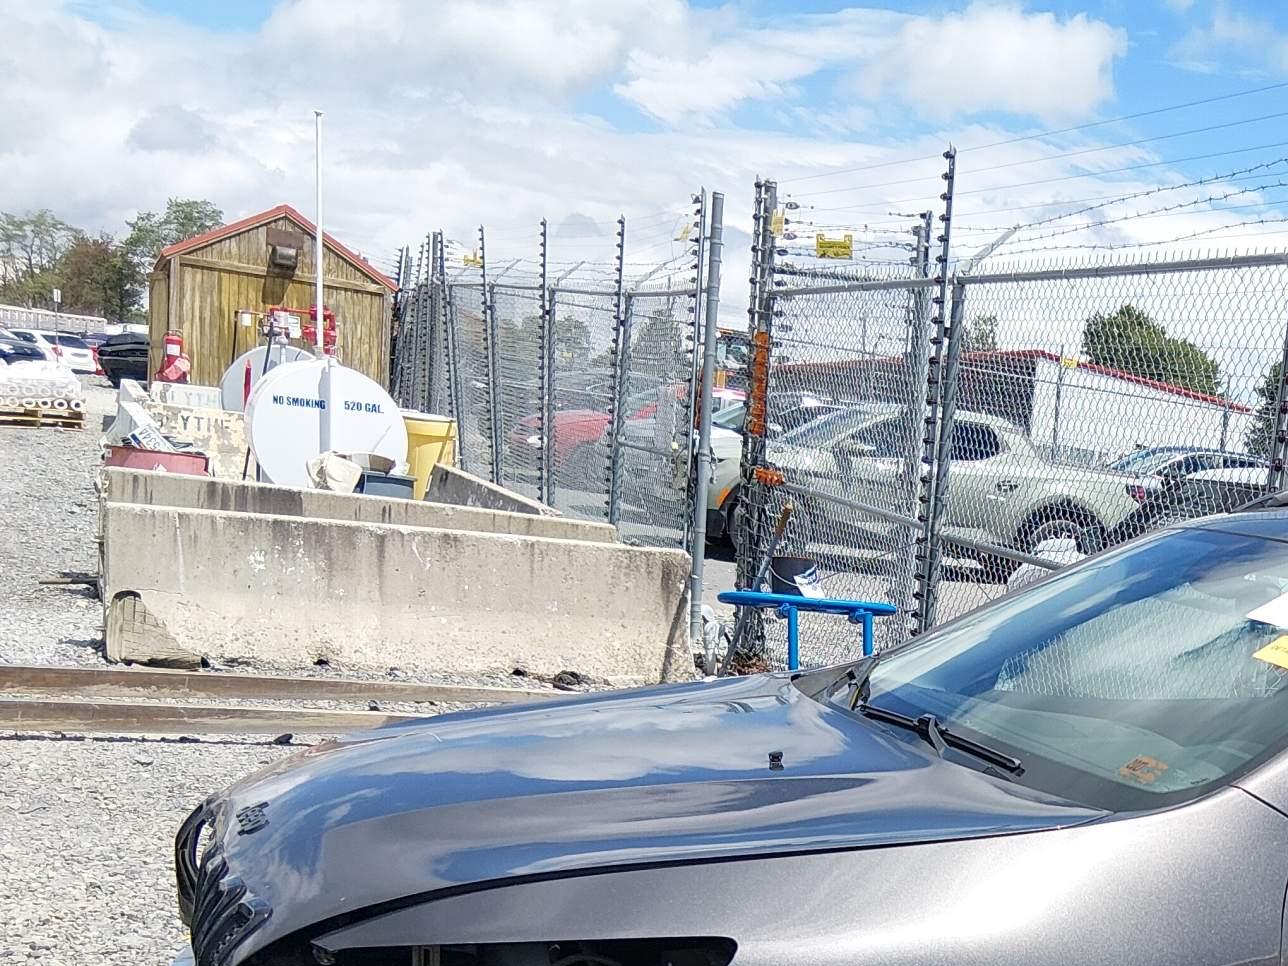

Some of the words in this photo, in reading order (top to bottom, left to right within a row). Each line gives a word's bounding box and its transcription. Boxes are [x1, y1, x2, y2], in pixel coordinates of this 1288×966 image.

[272, 394, 284, 405] NO
[286, 396, 326, 410] SMOKING
[344, 401, 362, 411] 520
